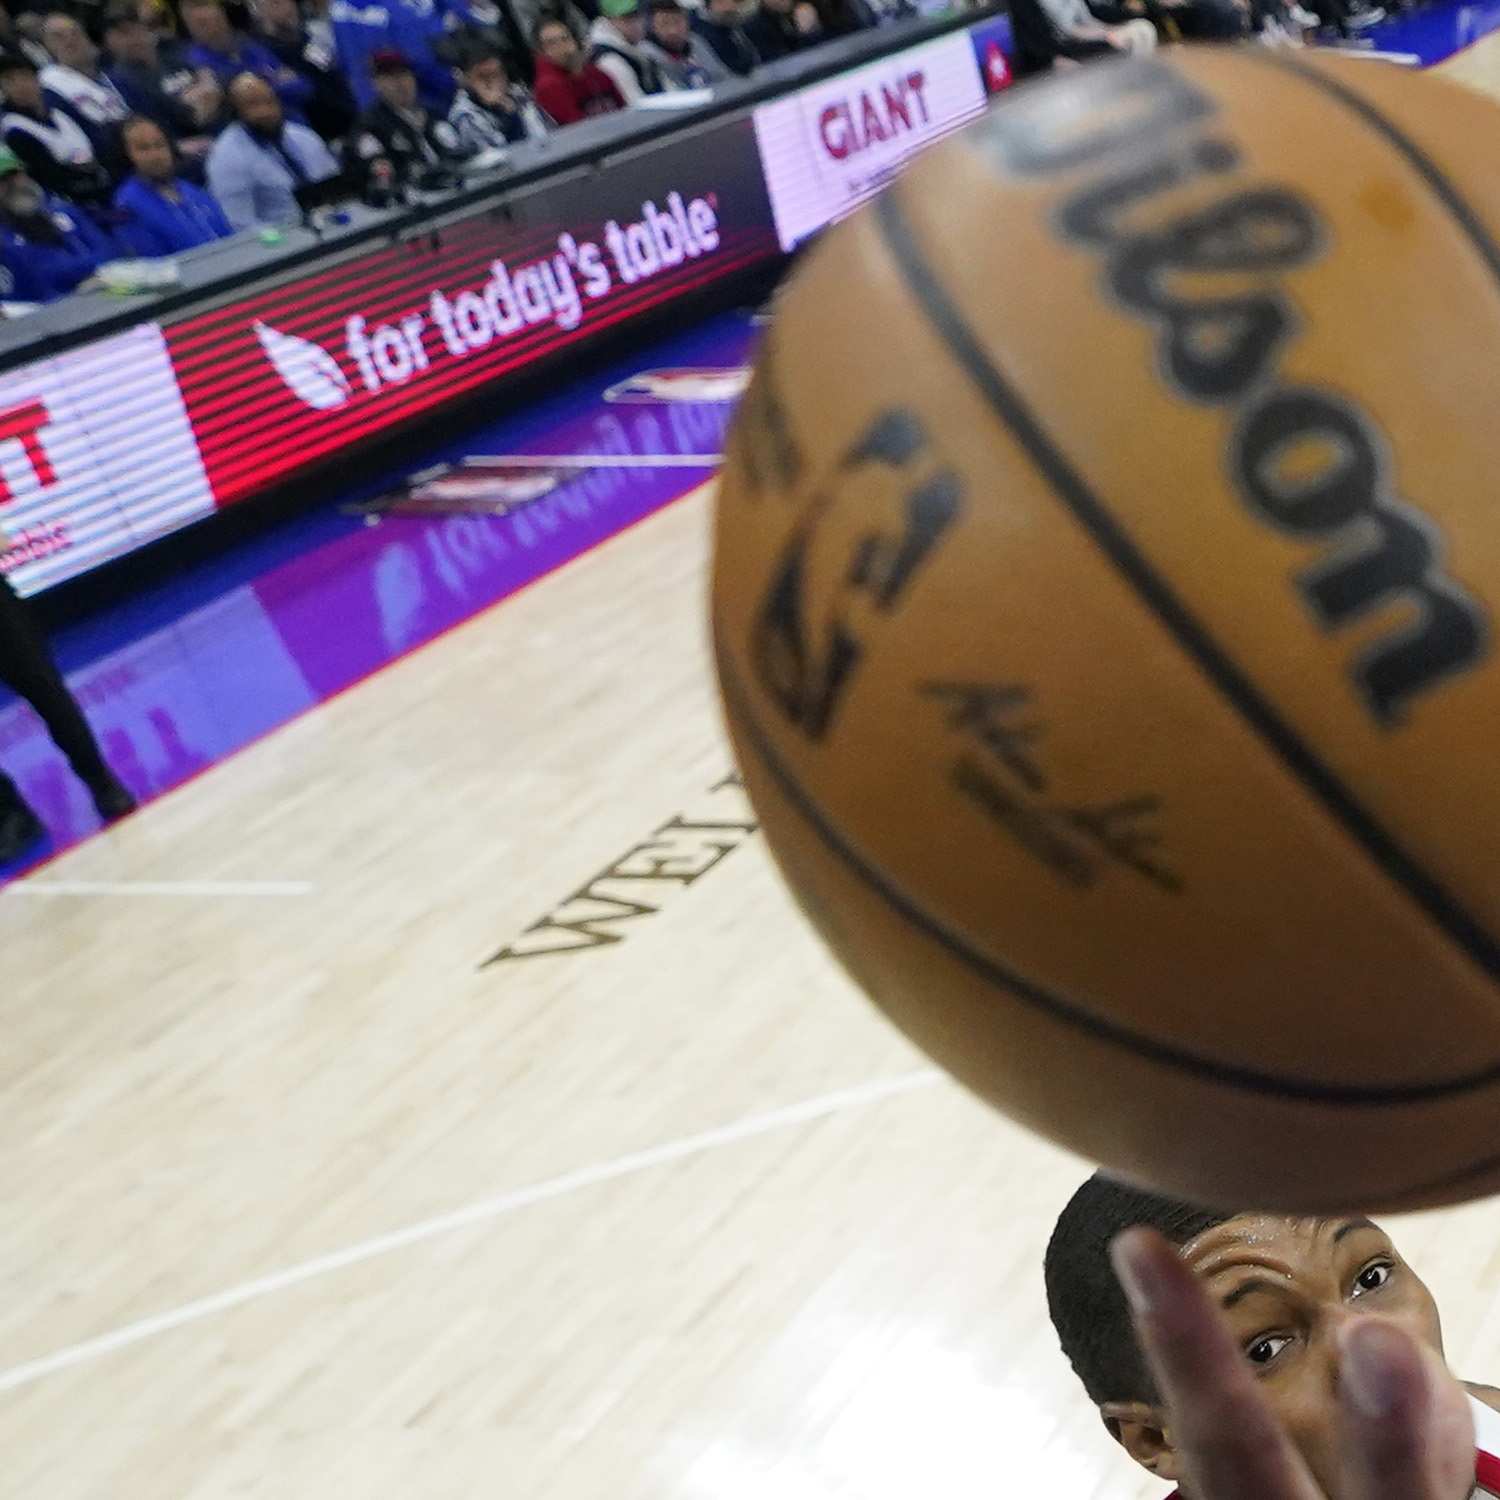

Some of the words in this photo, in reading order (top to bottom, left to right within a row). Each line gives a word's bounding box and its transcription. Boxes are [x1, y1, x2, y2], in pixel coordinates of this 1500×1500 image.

[818, 69, 931, 161] GIANT
[346, 313, 430, 394] for
[430, 230, 612, 357] today's
[604, 190, 721, 285] table
[477, 770, 761, 972] WEL
